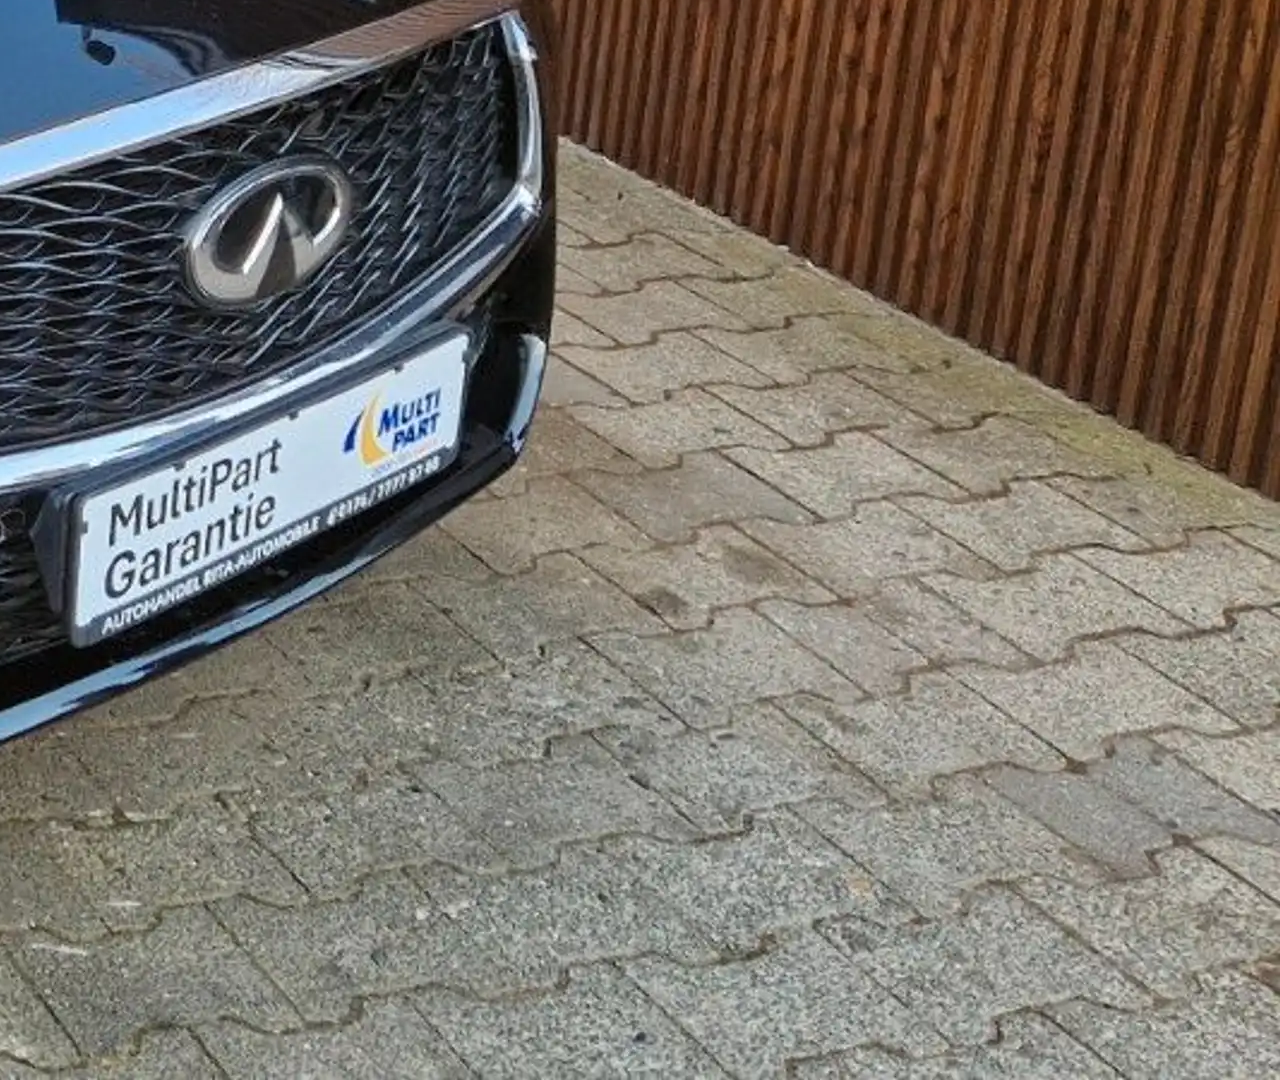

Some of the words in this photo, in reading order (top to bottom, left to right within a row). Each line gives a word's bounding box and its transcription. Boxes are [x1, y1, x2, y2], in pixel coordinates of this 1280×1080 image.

[376, 386, 441, 437] MULTI
[392, 411, 441, 452] PART
[108, 437, 282, 548] MultiPart
[104, 492, 276, 599] Garantie
[101, 575, 202, 636] AUTOHANDEL
